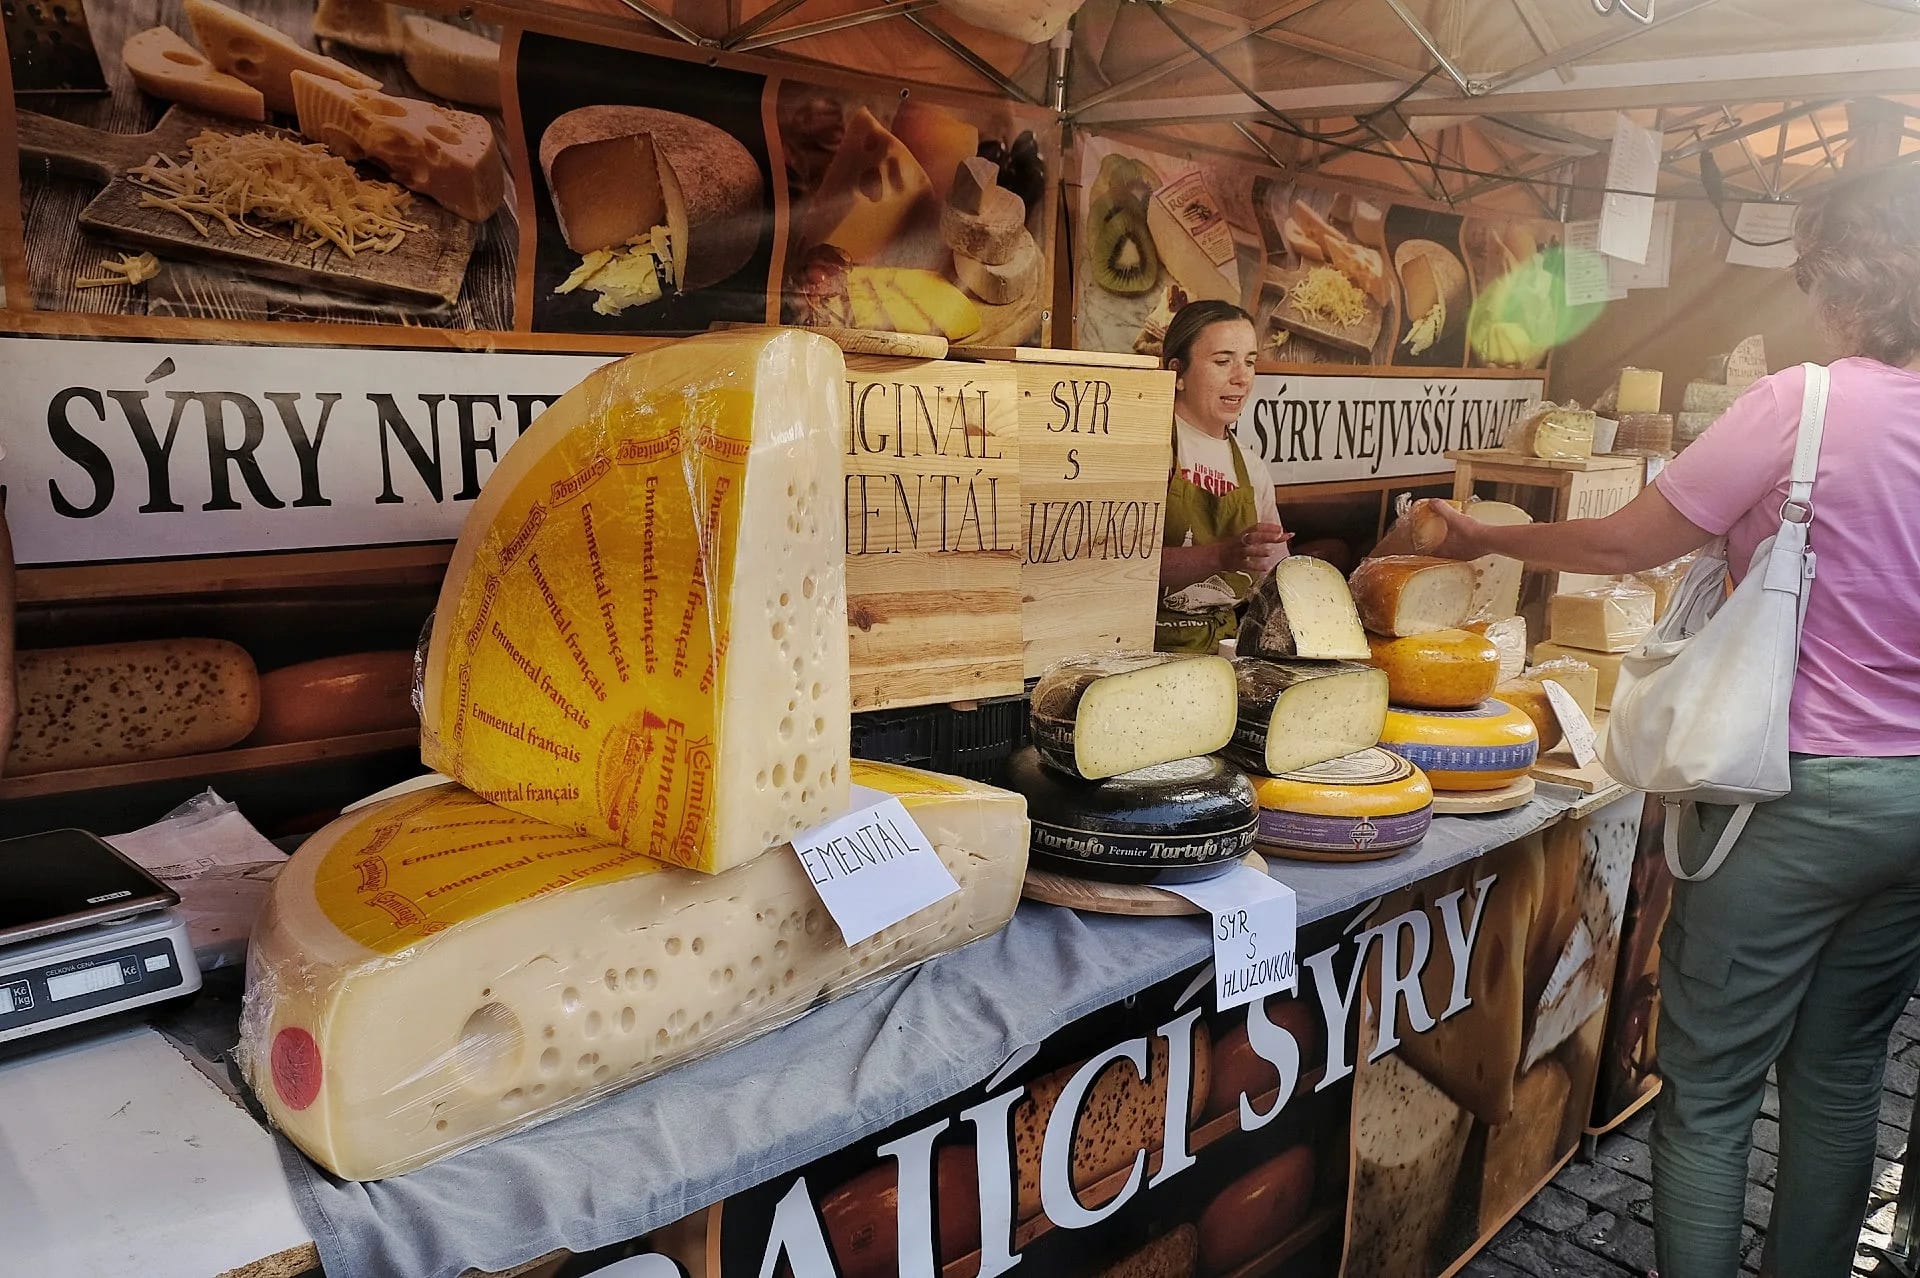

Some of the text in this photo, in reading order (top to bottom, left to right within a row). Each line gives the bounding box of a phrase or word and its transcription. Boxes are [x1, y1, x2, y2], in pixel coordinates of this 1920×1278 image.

[47, 356, 342, 519] SÝRY
[845, 380, 1002, 459] IGINÁL
[1047, 380, 1112, 434] SYR
[1250, 383, 1531, 474] SÝRY NEJVYŠŠÍ KVALIT
[1064, 448, 1080, 481] S
[1020, 500, 1160, 565] UZOVKOU
[581, 502, 630, 683] Emmental français
[528, 553, 572, 635] Emmental
[565, 632, 608, 702] français
[640, 588, 658, 674] français
[491, 620, 591, 730] Emmental français
[472, 702, 582, 764] Emmental français
[526, 782, 580, 806] français
[648, 717, 685, 858] Emmenta
[800, 811, 920, 885] EMENTÁL
[1034, 827, 1105, 858] Tartufo
[1108, 844, 1148, 858] Fermier
[1149, 838, 1218, 861] Tartufo
[1217, 909, 1250, 941] SYR
[1246, 932, 1257, 960] S
[13, 985, 28, 997] Kč
[77, 960, 96, 970] CENA
[123, 965, 138, 977] Kč
[1222, 949, 1296, 999] HLUZOVKOU
[1239, 873, 1497, 1132] SÝRY
